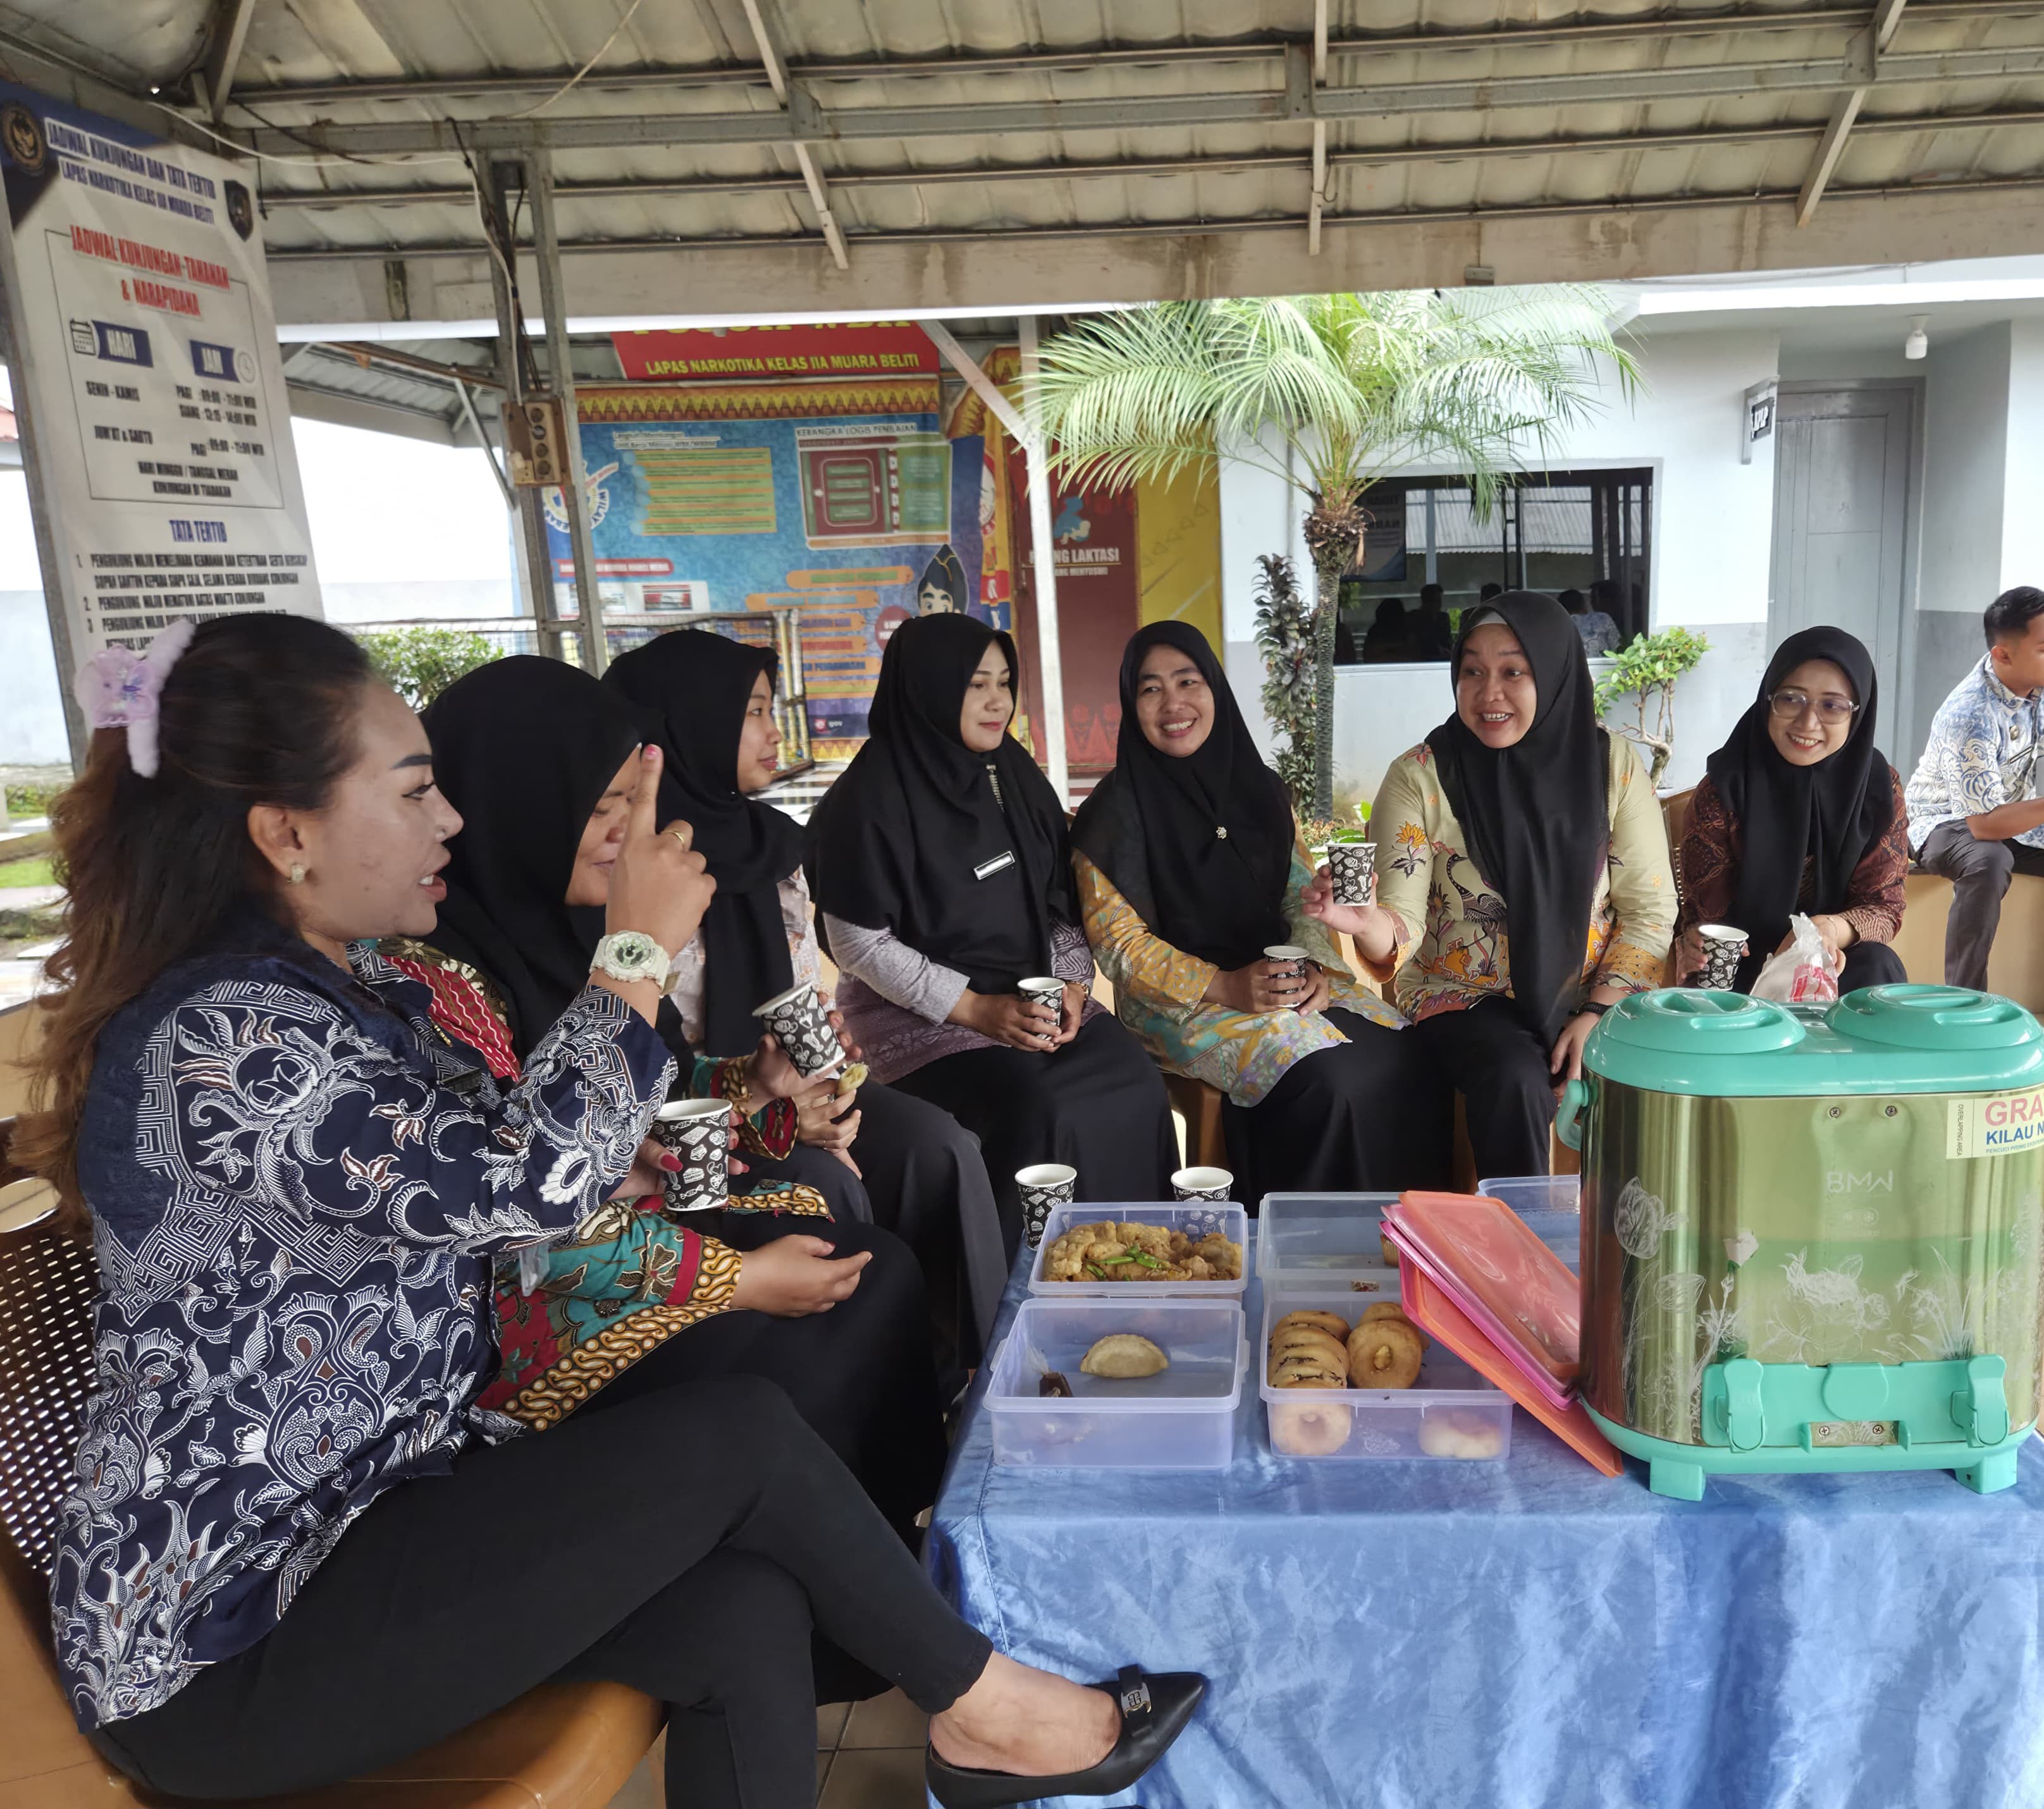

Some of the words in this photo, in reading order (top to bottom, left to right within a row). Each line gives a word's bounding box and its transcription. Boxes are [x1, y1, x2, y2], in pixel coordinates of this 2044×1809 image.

[63, 160, 87, 185] LAPAS
[88, 169, 133, 199] NARKOTIKA
[133, 184, 156, 207] KELAS
[70, 224, 118, 261] JADWAL
[118, 238, 182, 276] KUNJUNGAN
[184, 255, 230, 290] TAHANAN
[132, 278, 201, 317] NARAPIDANA
[106, 329, 137, 360] HARI
[201, 346, 223, 374] JAM
[646, 360, 689, 375] LAPAS
[691, 357, 763, 373] NARKOTIKA
[768, 355, 808, 371] KELAS
[810, 355, 828, 369] IIA
[832, 355, 878, 369] MUARA
[882, 354, 920, 367] BELITI
[797, 428, 842, 437] KERANGKA
[169, 520, 195, 543] TATA
[194, 521, 227, 543] TERTIB
[1071, 548, 1119, 562] LAKTASI
[1985, 1094, 2044, 1126] GRA
[1986, 1125, 2033, 1145] KILAU
[1827, 1170, 1893, 1193] BMW
